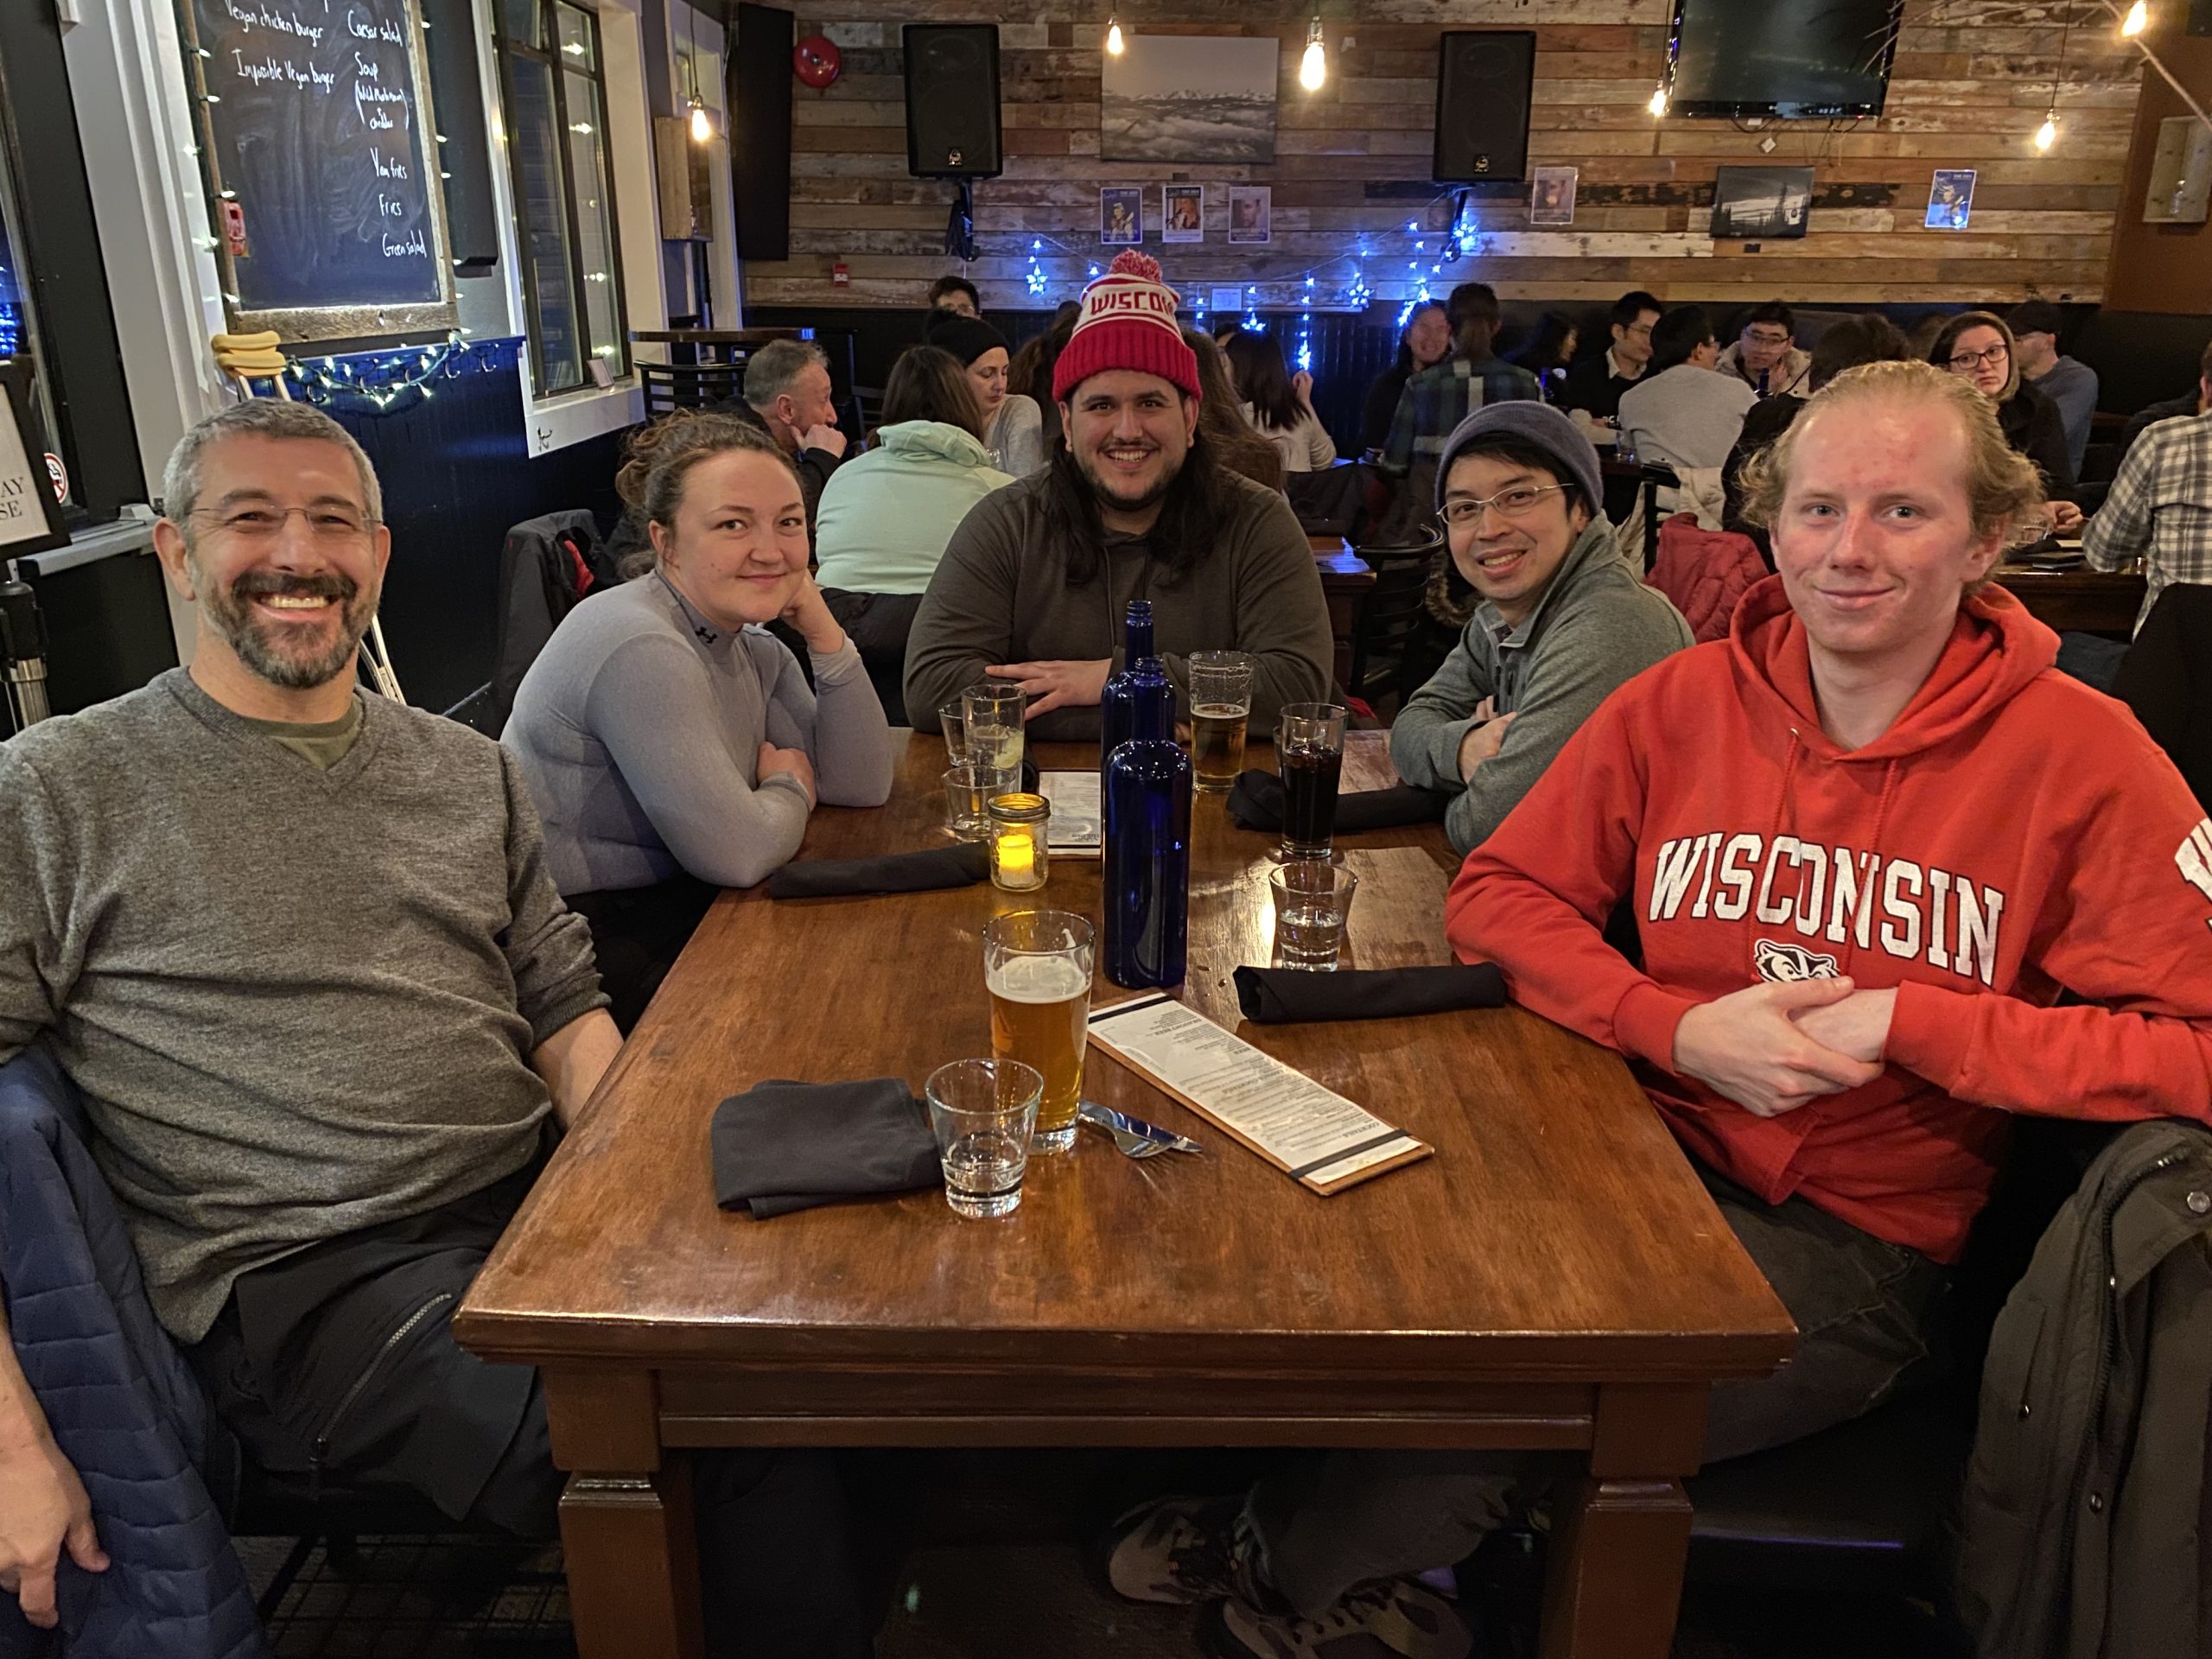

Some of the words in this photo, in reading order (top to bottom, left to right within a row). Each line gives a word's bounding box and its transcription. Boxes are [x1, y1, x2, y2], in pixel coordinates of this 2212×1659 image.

[225, 0, 257, 33] Vegan
[260, 3, 293, 33] chicken
[292, 12, 323, 47] burger
[347, 10, 377, 40] Caesar
[380, 18, 403, 48] salad
[231, 48, 283, 86] Impossible
[284, 60, 310, 90] Vegan
[309, 60, 334, 94] burger
[354, 51, 378, 82] Soup
[390, 156, 407, 180] fries
[378, 193, 402, 217] Fries
[382, 232, 406, 257] Green
[405, 229, 427, 258] salad
[0, 476, 24, 498] AY
[1648, 831, 2005, 988] WISCONSIN
